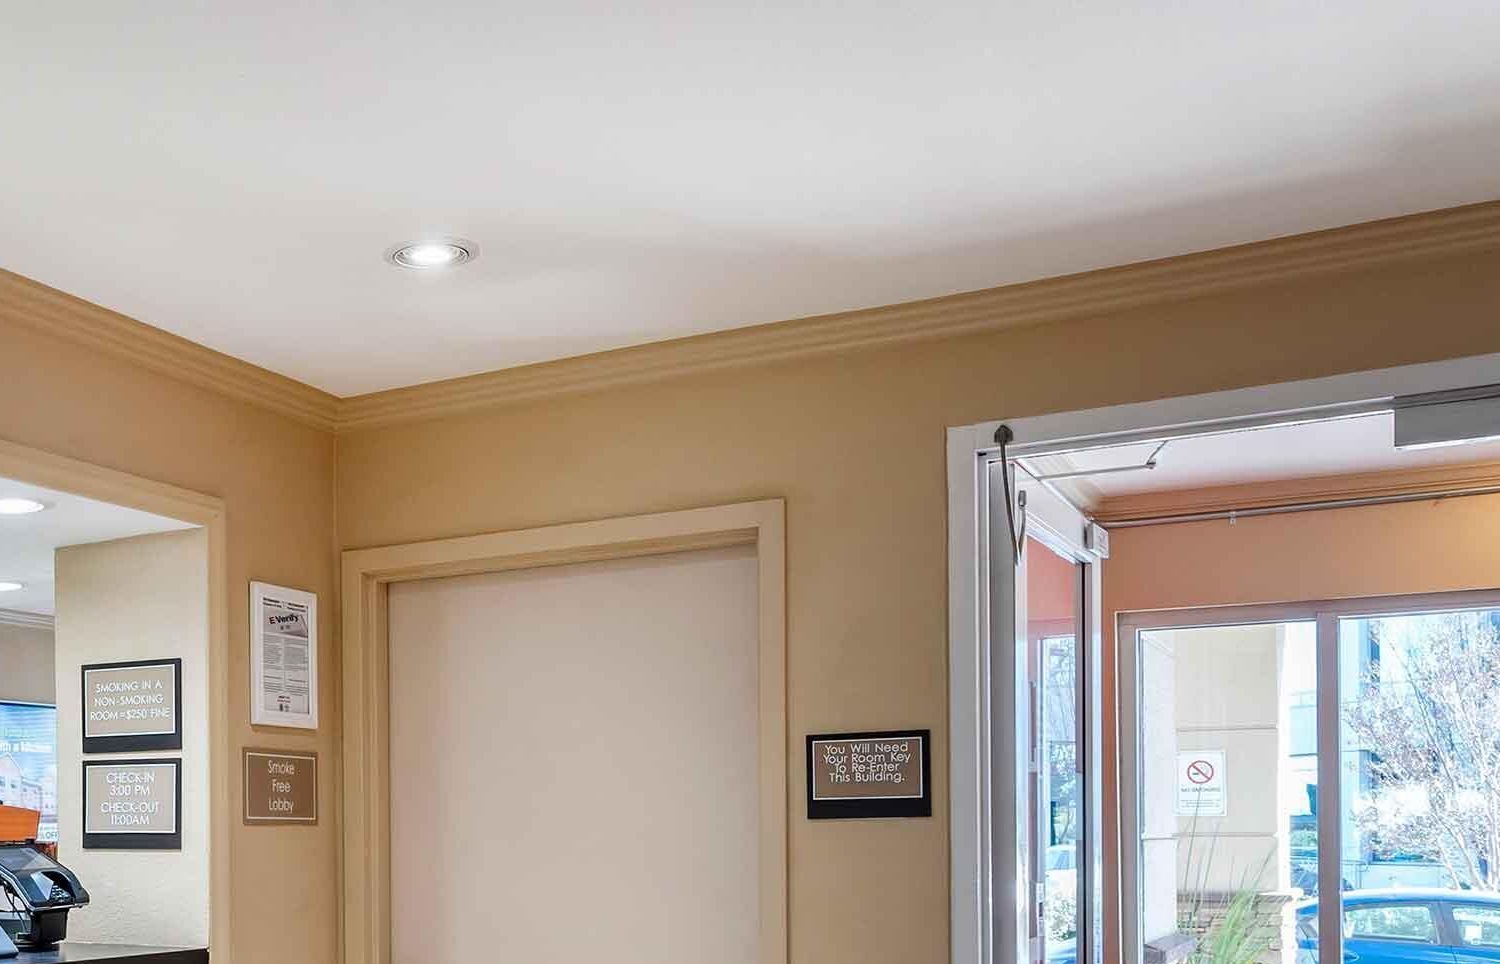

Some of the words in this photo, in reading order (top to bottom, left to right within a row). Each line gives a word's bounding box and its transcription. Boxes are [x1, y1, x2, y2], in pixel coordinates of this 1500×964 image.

[95, 681, 139, 693] SMOKING
[142, 680, 152, 689] IN
[155, 679, 163, 689] A
[150, 706, 171, 717] FINE
[825, 744, 846, 755] You
[850, 743, 870, 753] Will
[875, 741, 909, 753] Need
[823, 754, 848, 764] Your
[851, 753, 885, 763] Room
[891, 752, 911, 763] Key
[268, 759, 295, 775] Smoke
[835, 763, 847, 774] To
[851, 762, 899, 773] Re-Enter
[829, 772, 851, 783] This
[855, 771, 905, 783] Building.
[110, 785, 131, 796] 3:00
[134, 785, 150, 796] PM
[272, 778, 292, 793] Free
[268, 798, 294, 814] Lobby
